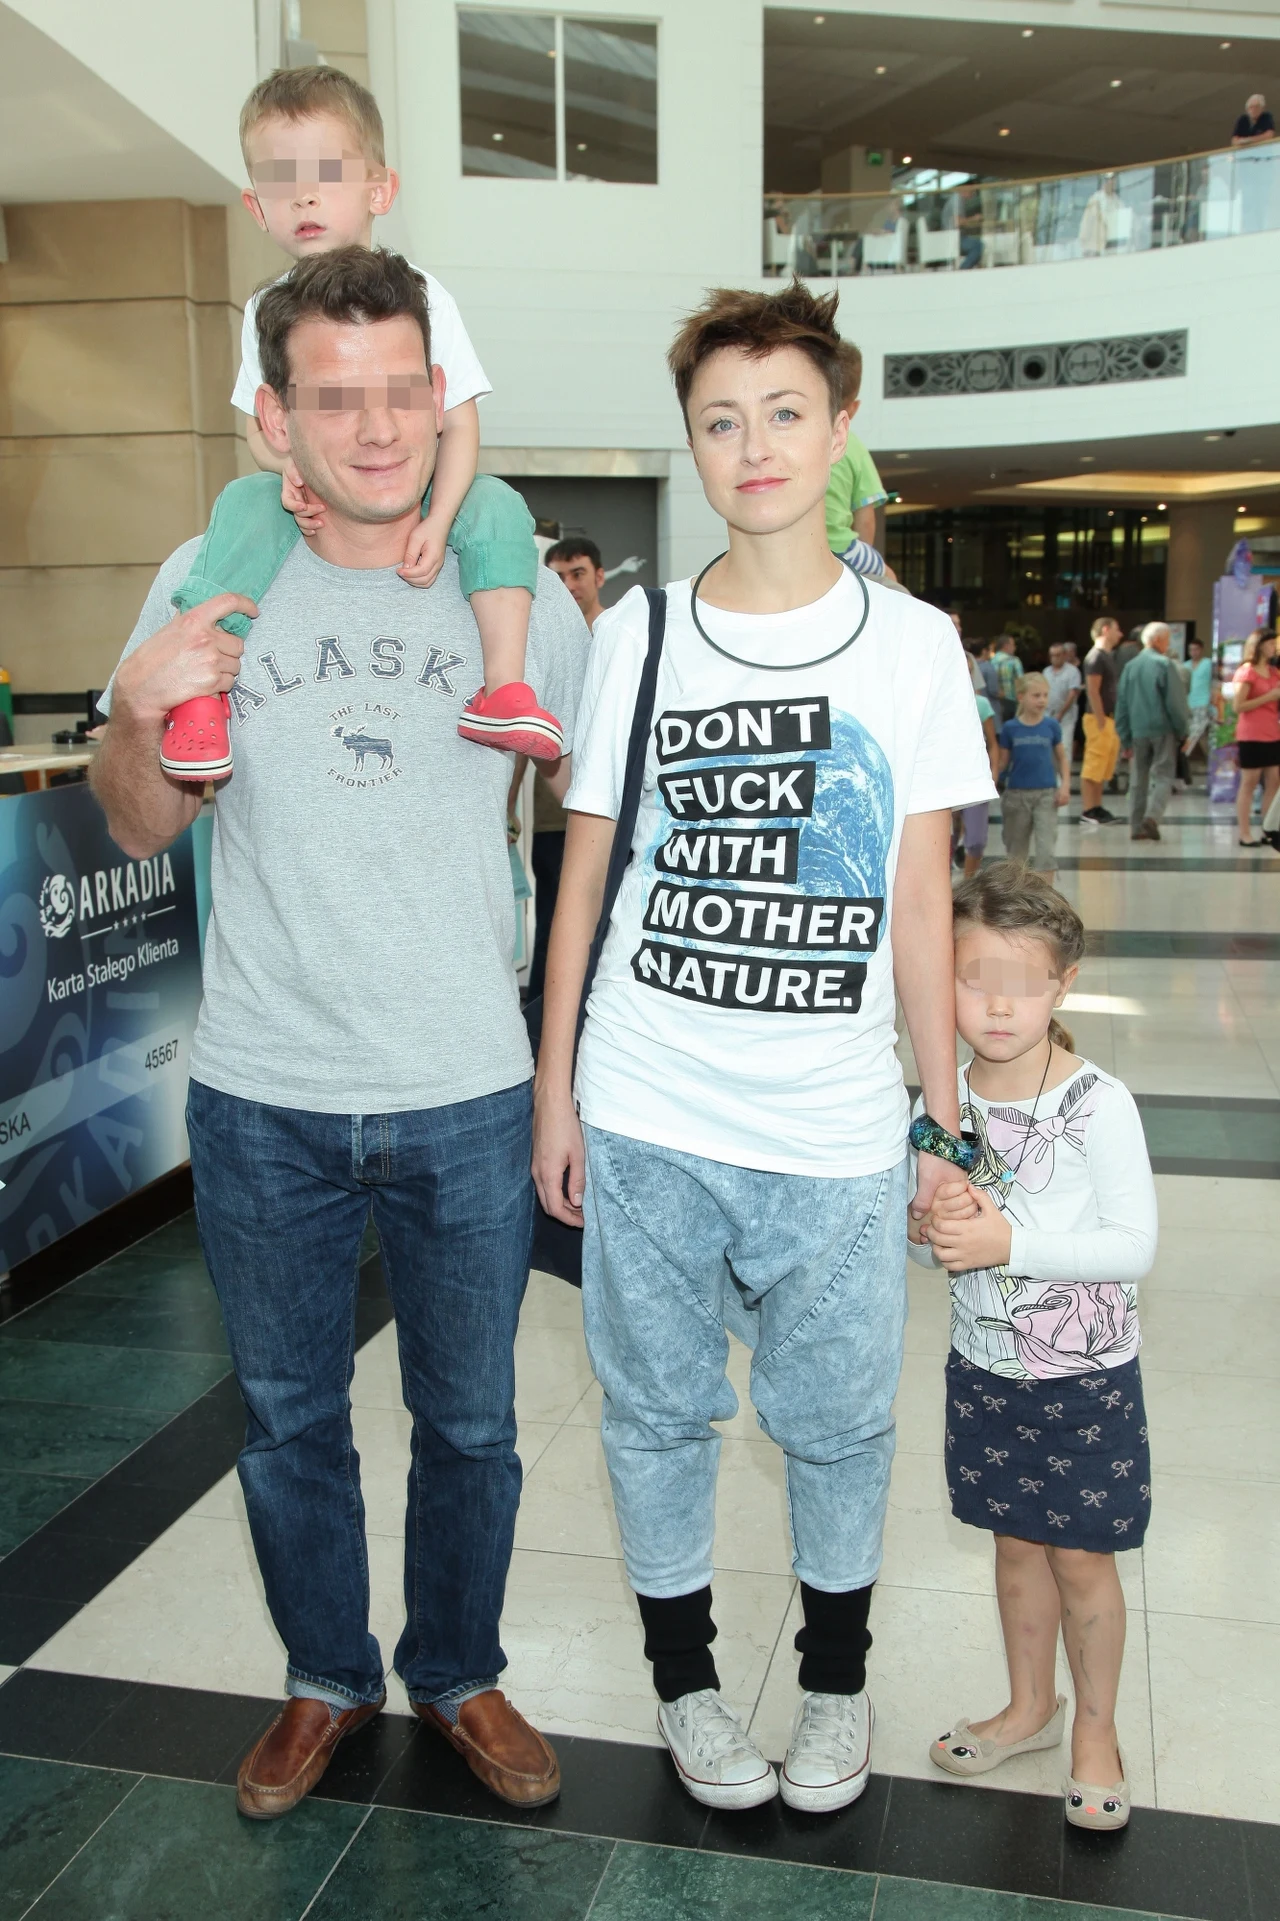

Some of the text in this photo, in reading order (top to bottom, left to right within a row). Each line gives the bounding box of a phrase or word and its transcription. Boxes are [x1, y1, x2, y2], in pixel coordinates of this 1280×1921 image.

[228, 635, 478, 727] ALASK
[329, 703, 402, 722] THE LAST
[660, 703, 820, 757] DON'T
[327, 767, 403, 788] FRONTIER
[664, 768, 806, 814] FUCK
[662, 834, 787, 876] WITH
[79, 852, 176, 921] ARKADIA
[650, 888, 876, 945] MOTHER
[47, 937, 180, 1003] Karta Stałego Klienta
[638, 947, 852, 1008] NATURE.
[144, 1039, 179, 1072] 45567
